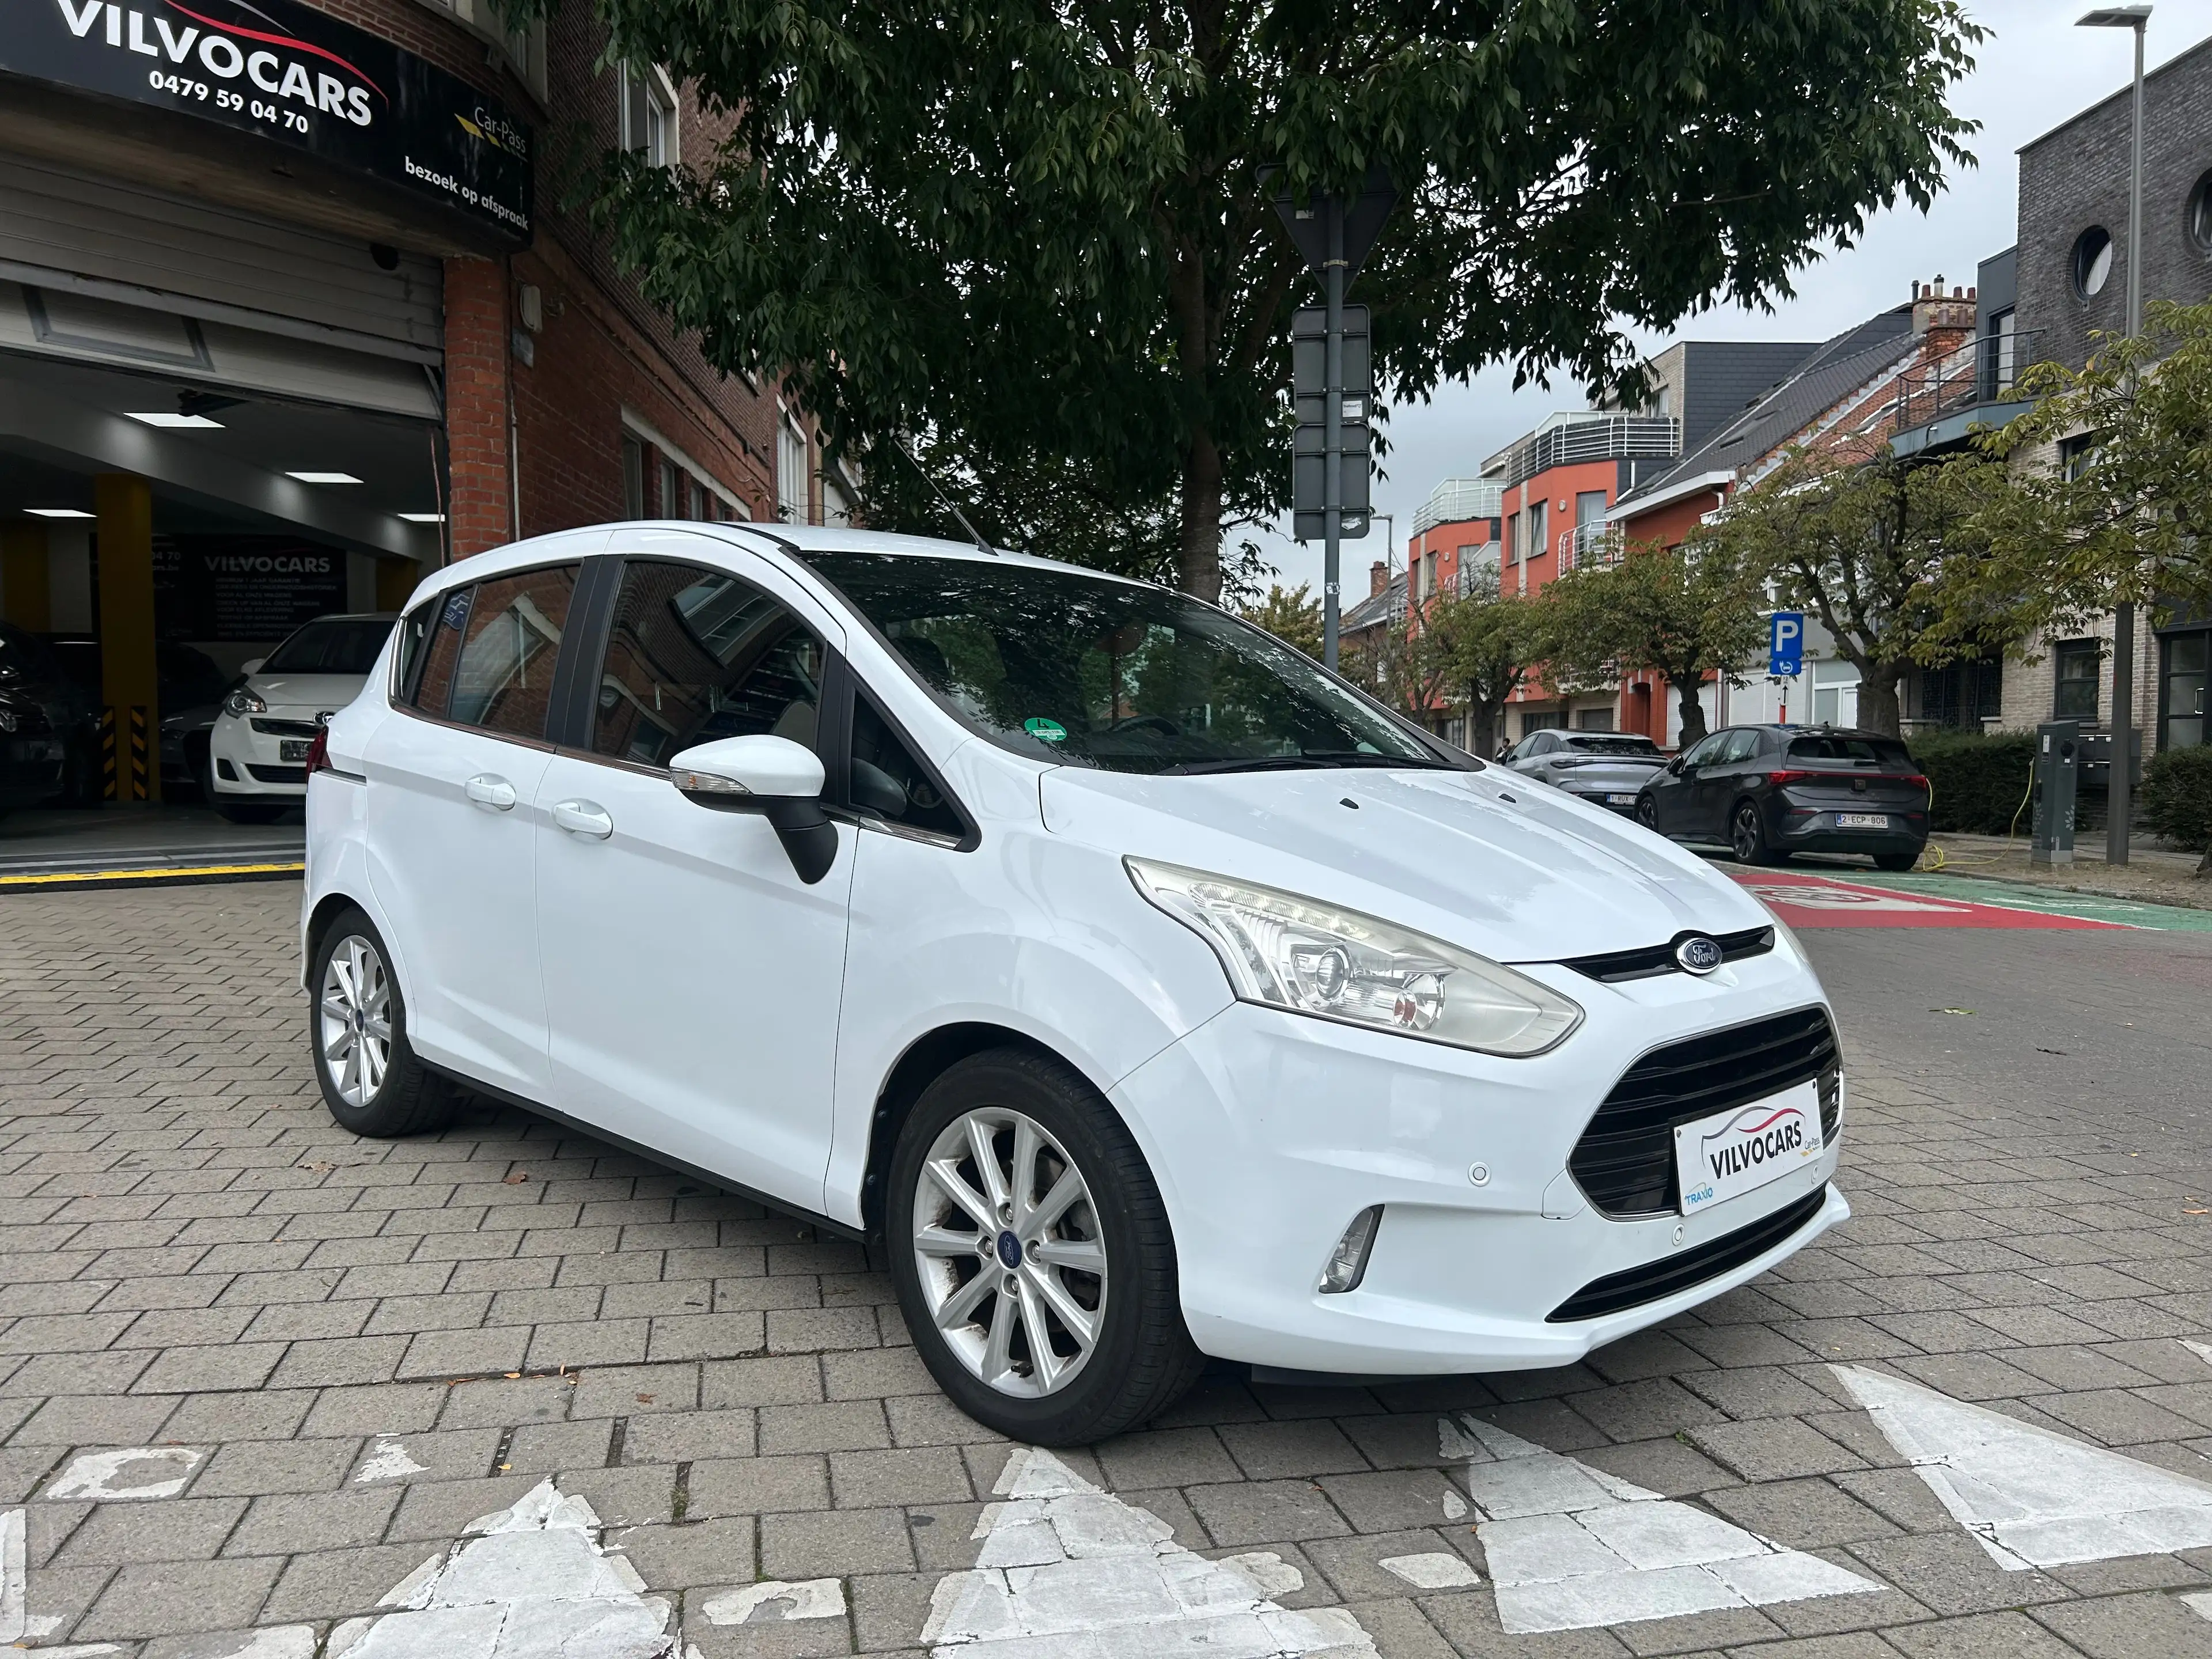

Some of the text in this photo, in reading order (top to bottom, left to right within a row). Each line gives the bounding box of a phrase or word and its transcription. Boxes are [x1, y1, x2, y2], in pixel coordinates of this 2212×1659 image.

[58, 0, 372, 126] VILVOCARS
[149, 70, 309, 133] 0479 59 04 70
[474, 106, 527, 154] Car-Pass
[404, 155, 529, 230] bezoek op afspraak
[166, 551, 181, 560] 70
[203, 555, 331, 573] VILVOCARS
[1775, 620, 1799, 652] P
[1692, 944, 1716, 964] Ford
[1709, 1120, 1802, 1179] VILVOCARS
[1685, 1187, 1713, 1205] TRAXIO
